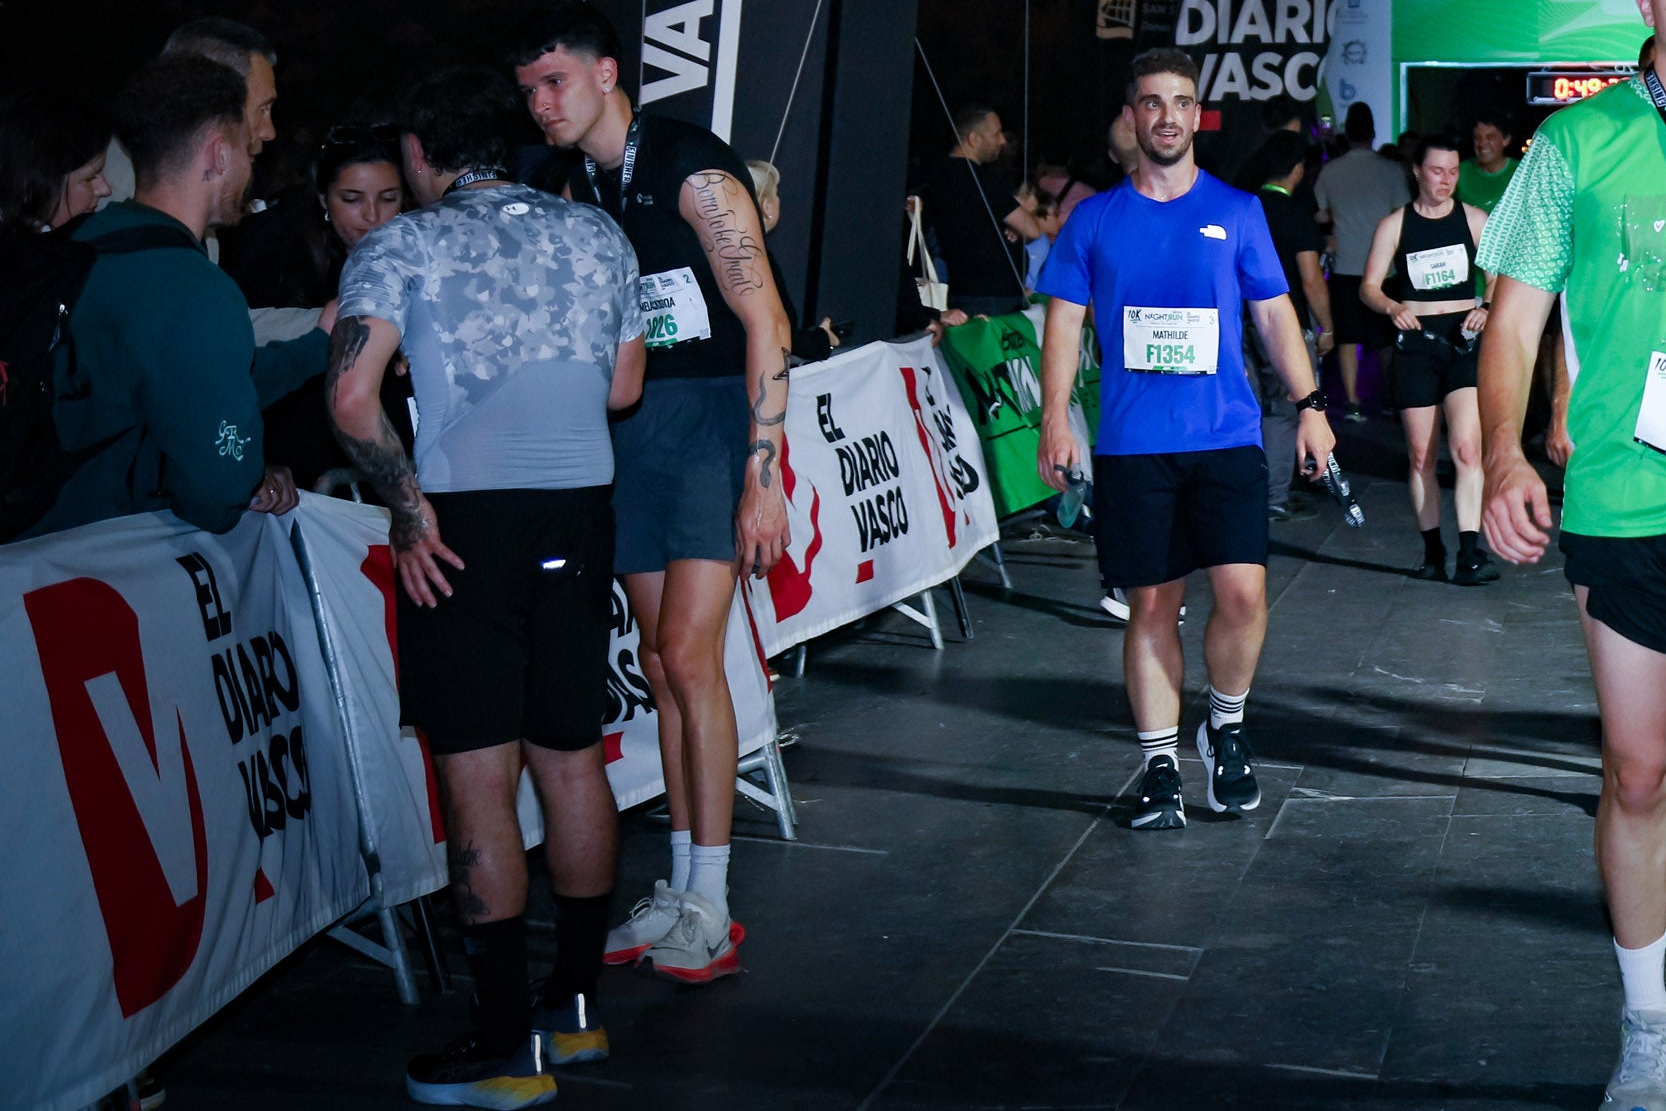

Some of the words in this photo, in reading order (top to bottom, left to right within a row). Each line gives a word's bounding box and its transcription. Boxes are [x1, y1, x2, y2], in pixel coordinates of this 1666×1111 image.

[622, 146, 637, 184] FINISHER
[683, 274, 691, 284] 2
[1425, 270, 1456, 286] F1164
[1127, 309, 1142, 322] 10K
[1152, 330, 1189, 340] MATHILDE
[1146, 344, 1195, 364] F1354
[816, 392, 846, 444] EL
[835, 430, 900, 497] DIARIO
[850, 486, 909, 553] VASCO
[176, 552, 232, 641] EL
